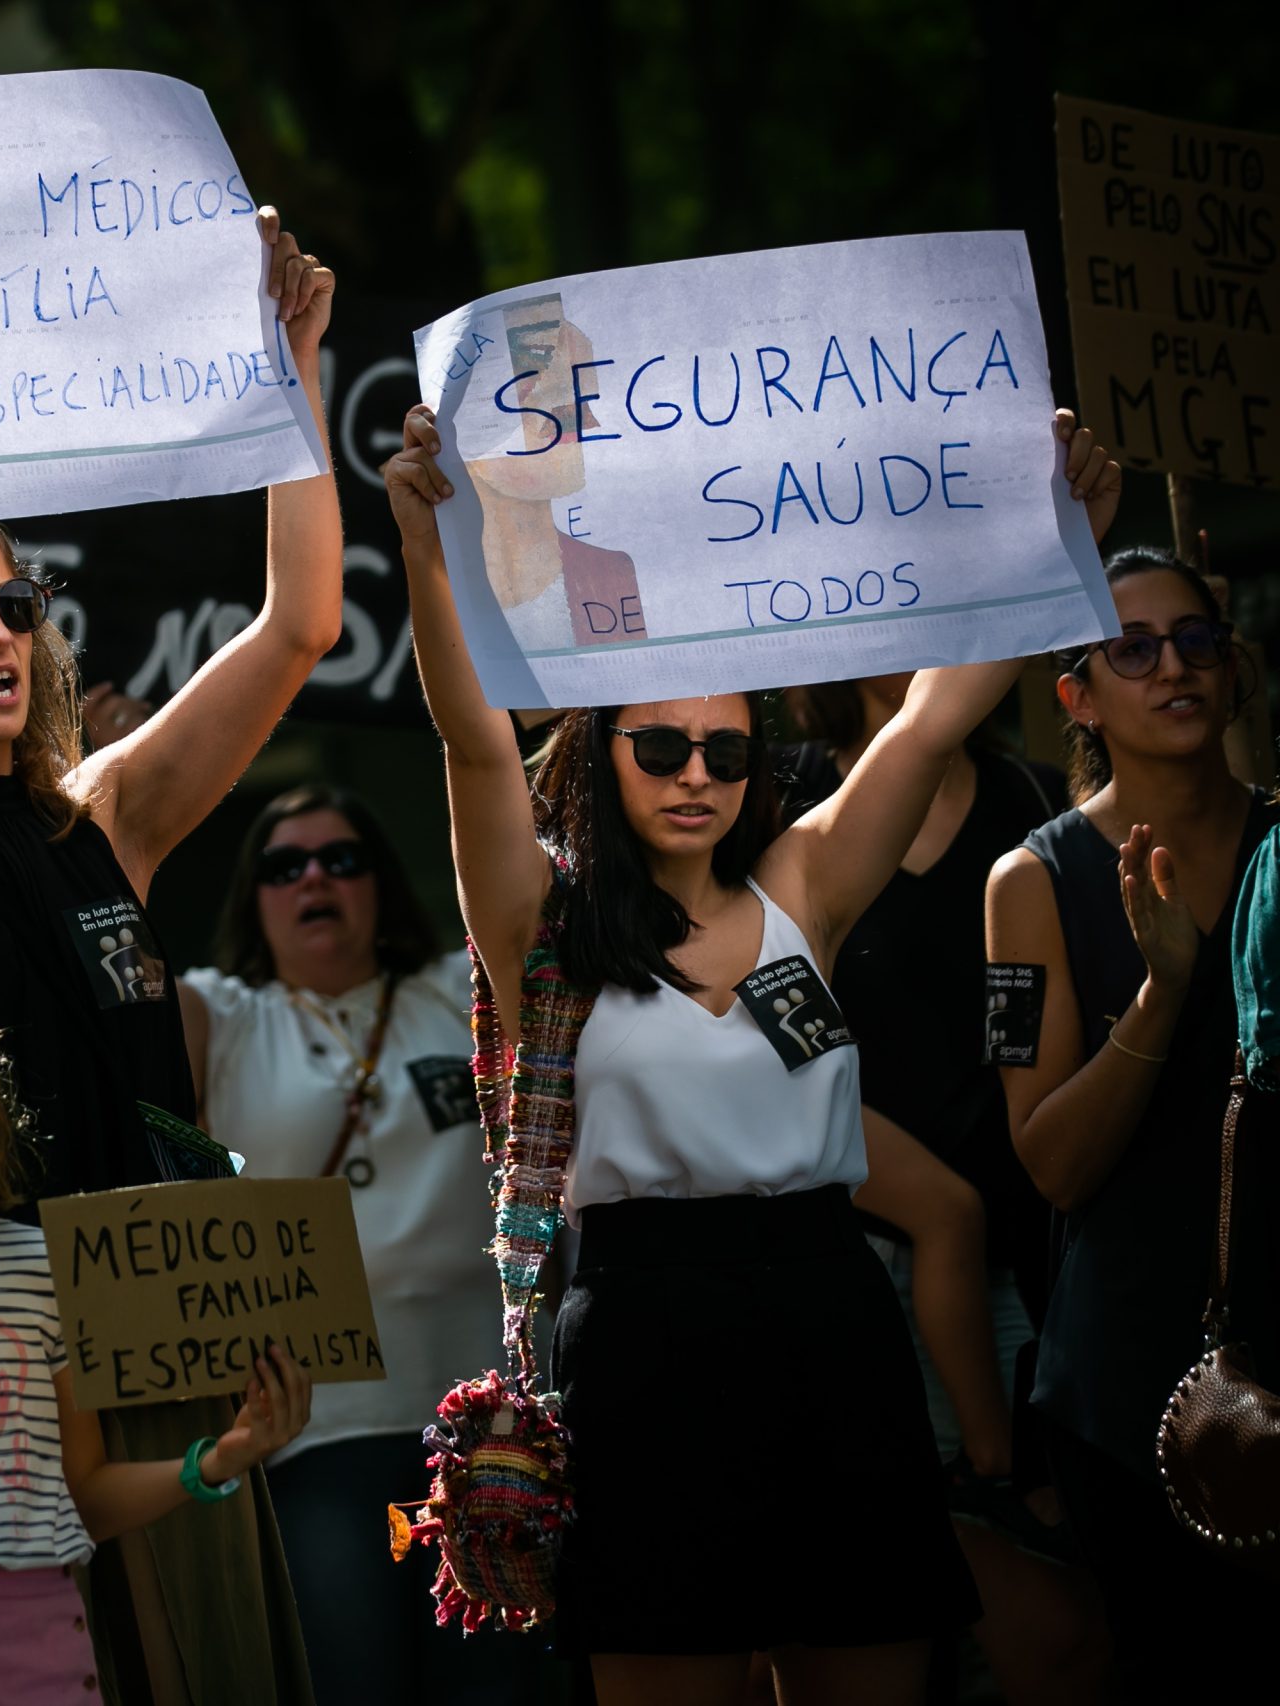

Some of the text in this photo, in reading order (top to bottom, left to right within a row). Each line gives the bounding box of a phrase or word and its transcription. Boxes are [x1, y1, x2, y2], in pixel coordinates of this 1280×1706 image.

[1080, 116, 1264, 193] DE LUTO
[1103, 177, 1277, 268] PELO SNS
[1087, 255, 1272, 336] EM LUTA
[493, 327, 1020, 457] SEGURANÇA
[1151, 332, 1238, 387] PELA
[1109, 373, 1272, 487] MGF
[567, 437, 985, 542] E SAÚDE
[582, 561, 922, 635] DE TODOS
[78, 912, 91, 921] De
[92, 907, 110, 918] luto
[82, 922, 97, 932] Em
[96, 918, 114, 928] luta
[746, 979, 759, 989] De
[758, 971, 774, 982] luto
[753, 987, 767, 998] Em
[73, 1198, 316, 1288] MÉDICO DE
[176, 1265, 319, 1323] FAMILIA
[75, 1319, 101, 1375] É
